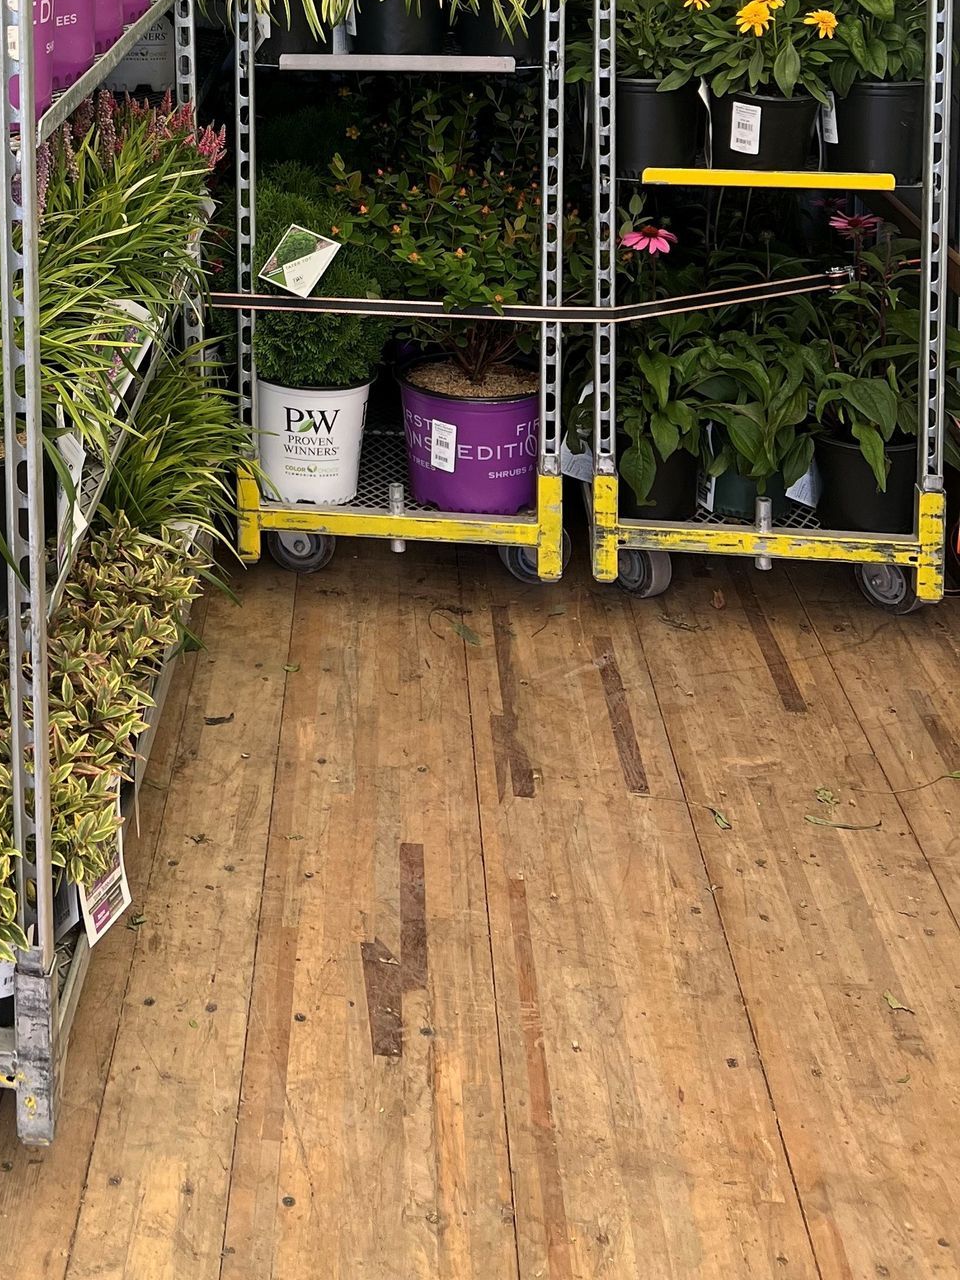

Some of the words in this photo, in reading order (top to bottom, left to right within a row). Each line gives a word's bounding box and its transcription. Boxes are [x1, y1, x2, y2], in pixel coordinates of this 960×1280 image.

[288, 435, 334, 447] PROVEN
[283, 444, 338, 457] WINNERS
[285, 464, 306, 472] COLOR
[488, 466, 527, 479] SHRUBS
